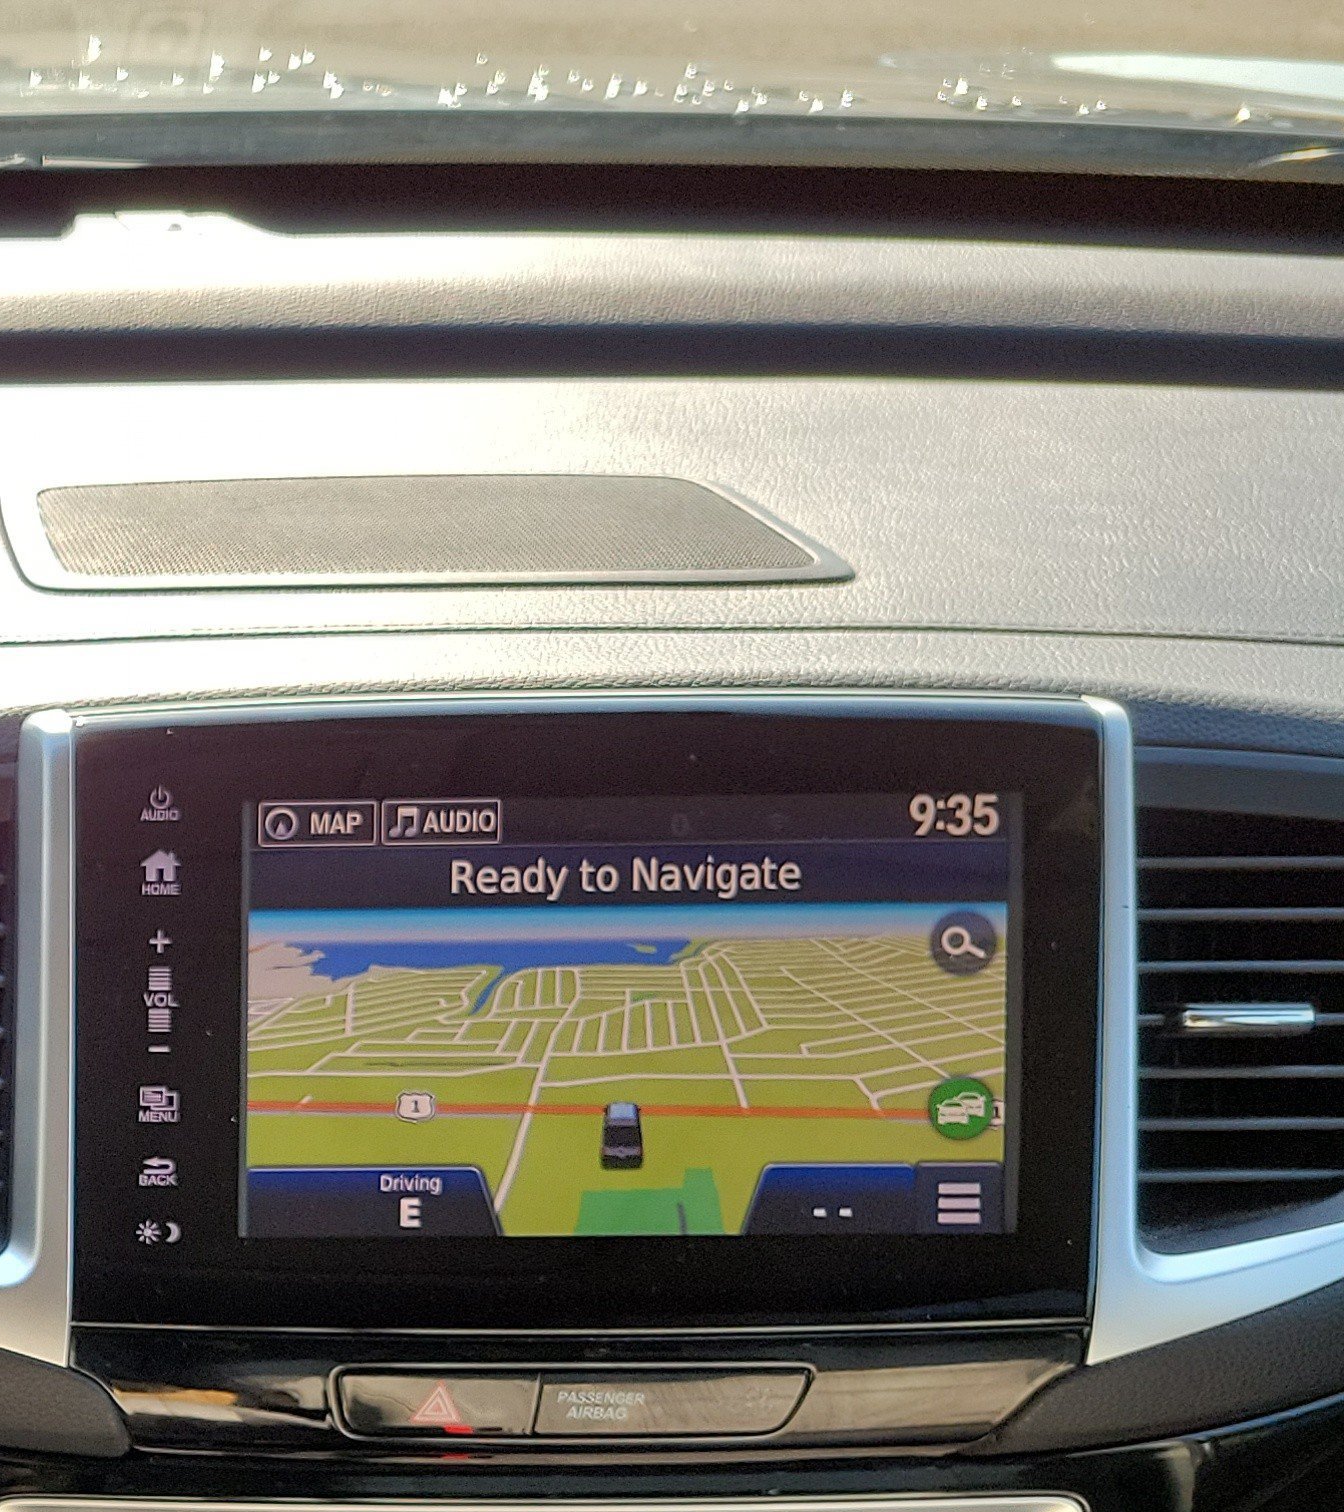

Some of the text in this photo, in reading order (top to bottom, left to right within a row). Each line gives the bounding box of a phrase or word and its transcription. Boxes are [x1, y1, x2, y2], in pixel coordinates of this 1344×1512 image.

[140, 809, 179, 821] AUDIO
[423, 809, 497, 834] AUDIO
[910, 794, 1000, 836] 9:35
[310, 810, 362, 835] MAP
[450, 855, 801, 901] Ready to Navigate
[141, 883, 180, 895] HOME
[144, 993, 179, 1008] VOL
[411, 1099, 419, 1113] 1
[138, 1110, 179, 1123] MENU
[138, 1174, 177, 1187] BACK
[380, 1174, 443, 1195] Driving
[399, 1197, 422, 1228] E
[557, 1391, 645, 1405] PASSENGER
[566, 1407, 628, 1420] AIRBAG
